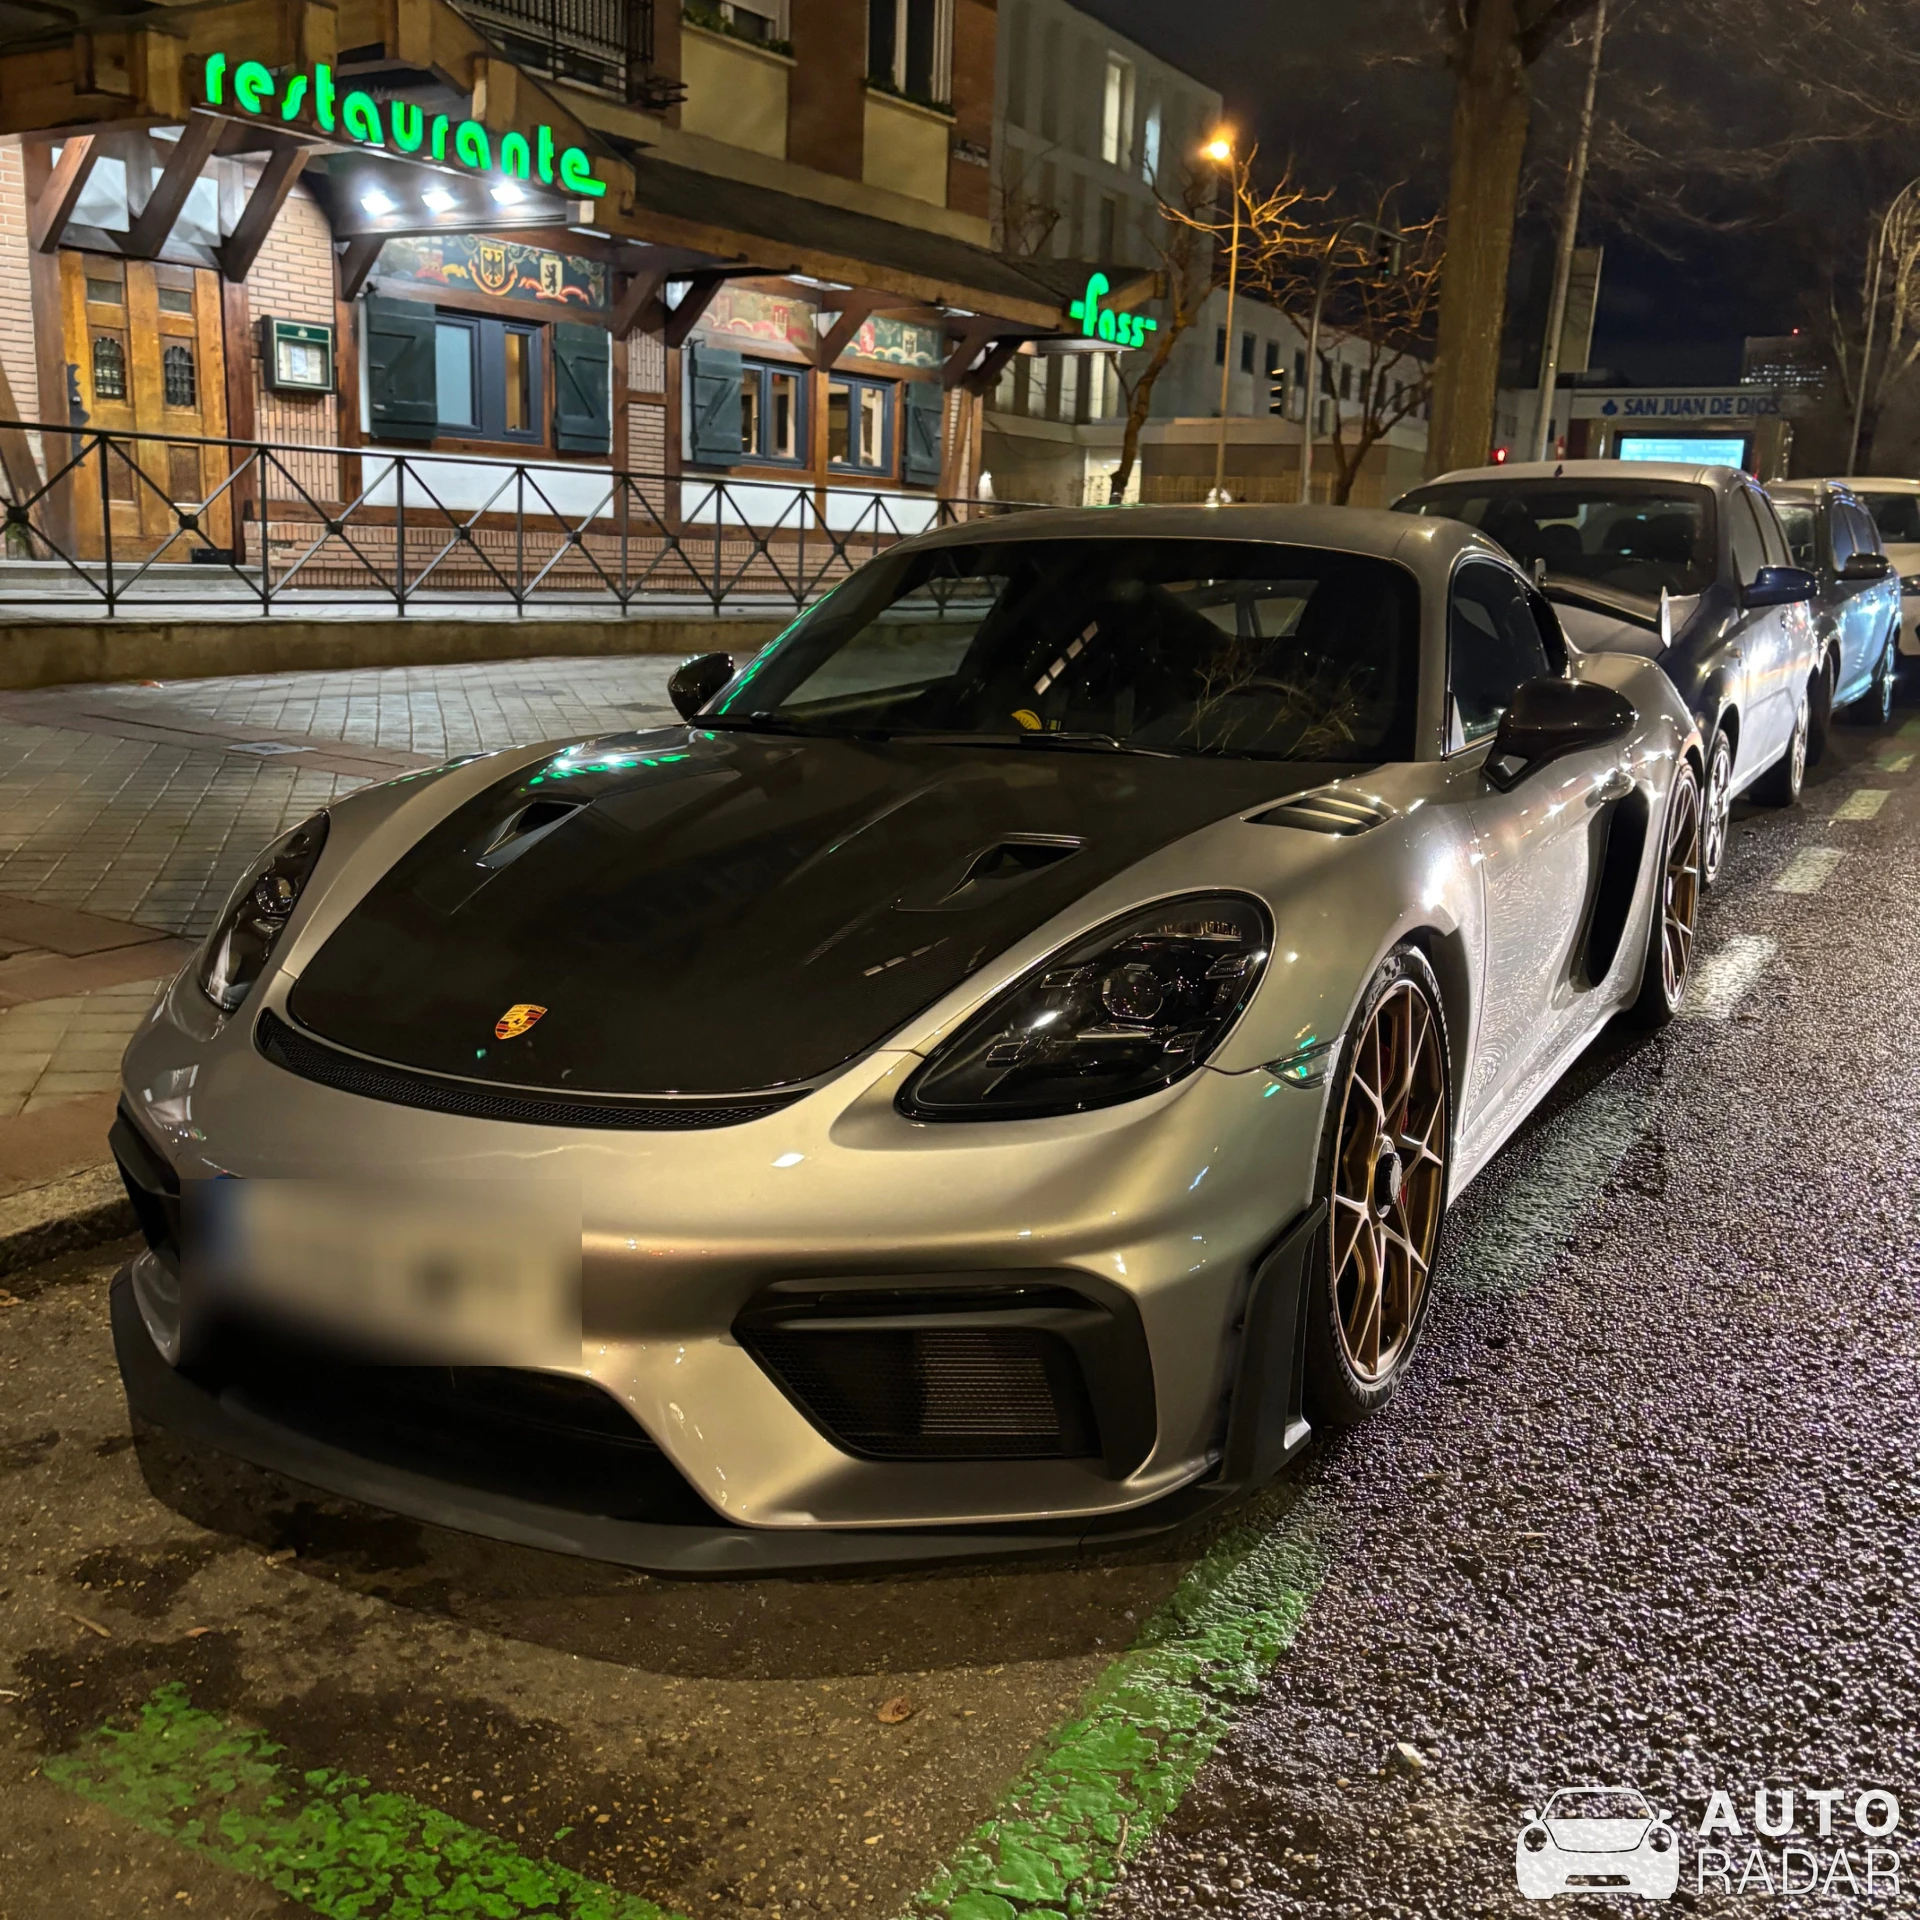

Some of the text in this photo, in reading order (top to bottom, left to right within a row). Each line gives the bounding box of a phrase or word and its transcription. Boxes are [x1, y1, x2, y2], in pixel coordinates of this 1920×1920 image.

[205, 52, 607, 197] restaurante
[1069, 272, 1158, 348] fass
[1624, 396, 1780, 416] SAN JUAN DE DIOS
